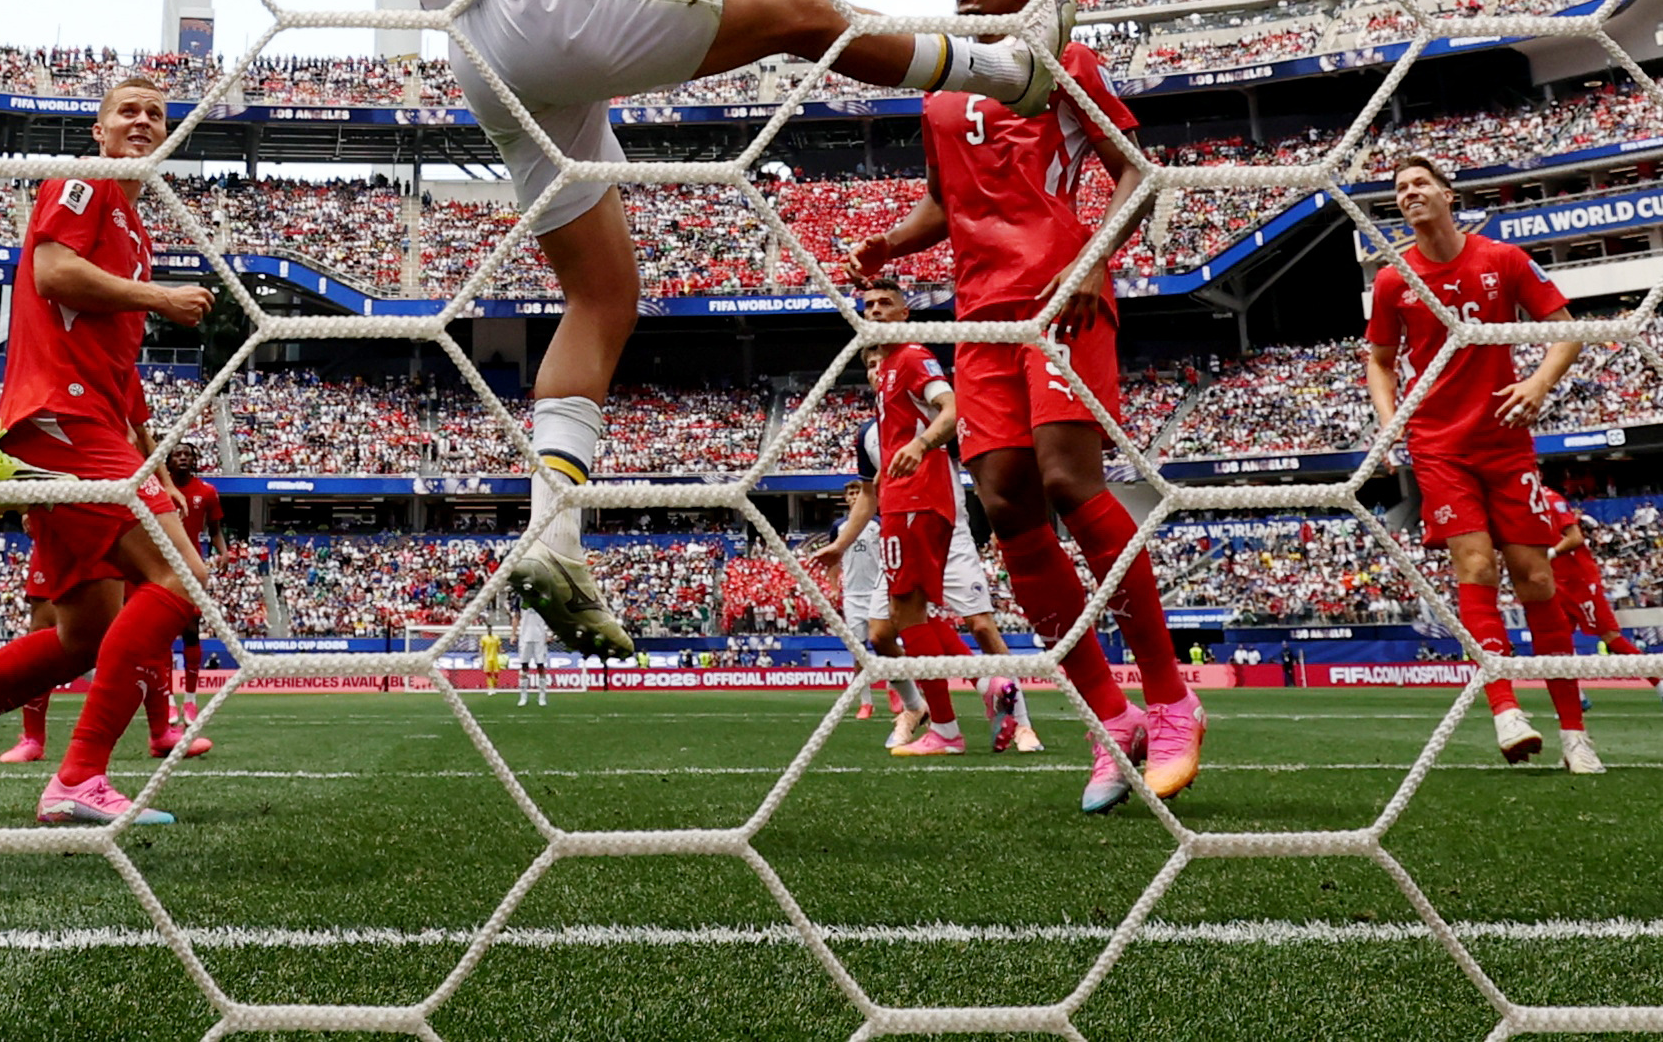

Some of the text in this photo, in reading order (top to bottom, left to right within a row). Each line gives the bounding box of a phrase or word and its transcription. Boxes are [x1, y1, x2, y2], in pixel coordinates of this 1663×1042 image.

[1188, 65, 1273, 86] LOS ANGELES
[10, 96, 36, 109] FIFA
[35, 99, 74, 112] WORLD
[268, 108, 350, 121] LOS ANGELES
[965, 94, 987, 145] 5
[1500, 214, 1550, 240] FIFA
[1550, 200, 1634, 232] WORLD
[708, 299, 736, 312] FIFA
[736, 299, 783, 312] WORLD
[784, 298, 811, 311] CUP
[1214, 457, 1301, 474] LOS ANGELES
[243, 641, 348, 651] FIFA WORLD CUP 2026
[611, 674, 642, 689] CUP
[643, 673, 697, 688] 2026
[702, 672, 763, 687] OFFICIAL
[764, 671, 854, 686] HOSPITALITY
